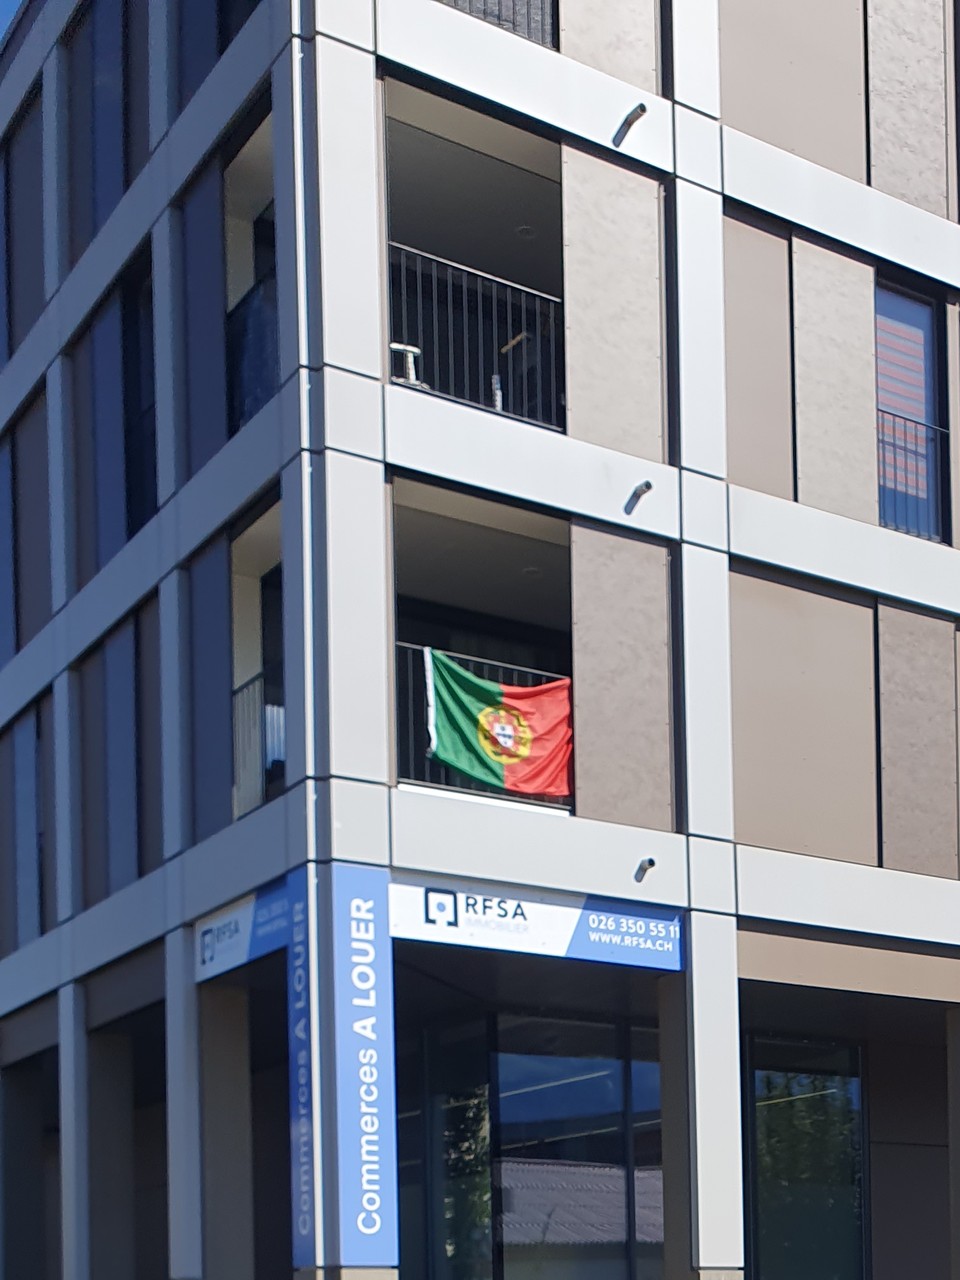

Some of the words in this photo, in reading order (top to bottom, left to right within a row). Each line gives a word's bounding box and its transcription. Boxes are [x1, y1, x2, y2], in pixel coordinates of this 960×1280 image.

[465, 895, 528, 922] RFSA
[588, 914, 616, 931] 026
[619, 918, 646, 934] 350
[649, 922, 667, 937] 55
[668, 924, 680, 940] 11
[350, 898, 376, 1008] LOUER
[588, 931, 673, 952] WWW.RFSA.CH
[352, 1016, 377, 1040] A
[357, 1048, 382, 1235] Commerces
